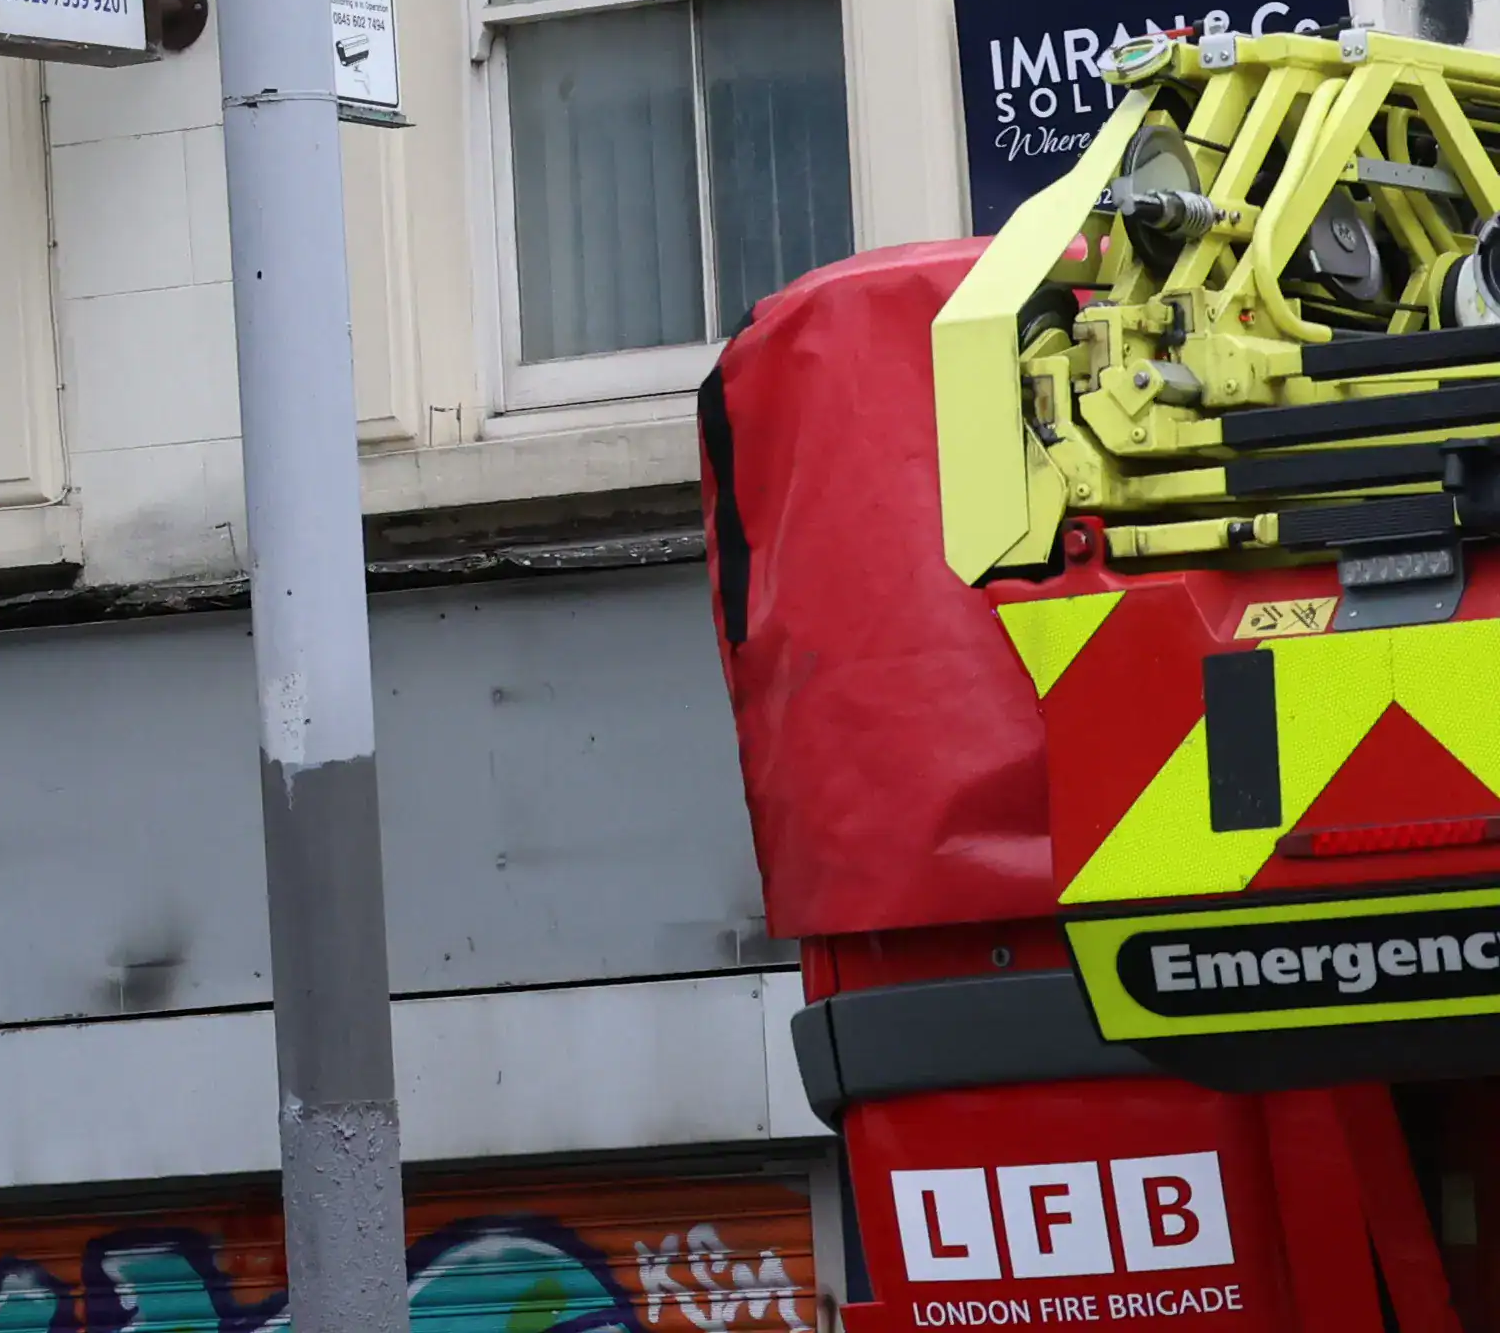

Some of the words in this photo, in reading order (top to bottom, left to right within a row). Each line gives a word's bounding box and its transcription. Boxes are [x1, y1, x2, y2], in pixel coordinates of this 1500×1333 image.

[995, 125, 1091, 161] Where
[913, 1299, 1031, 1327] LONDON
[1040, 1295, 1100, 1322] FIRE
[1107, 1284, 1244, 1320] BRIGADE
